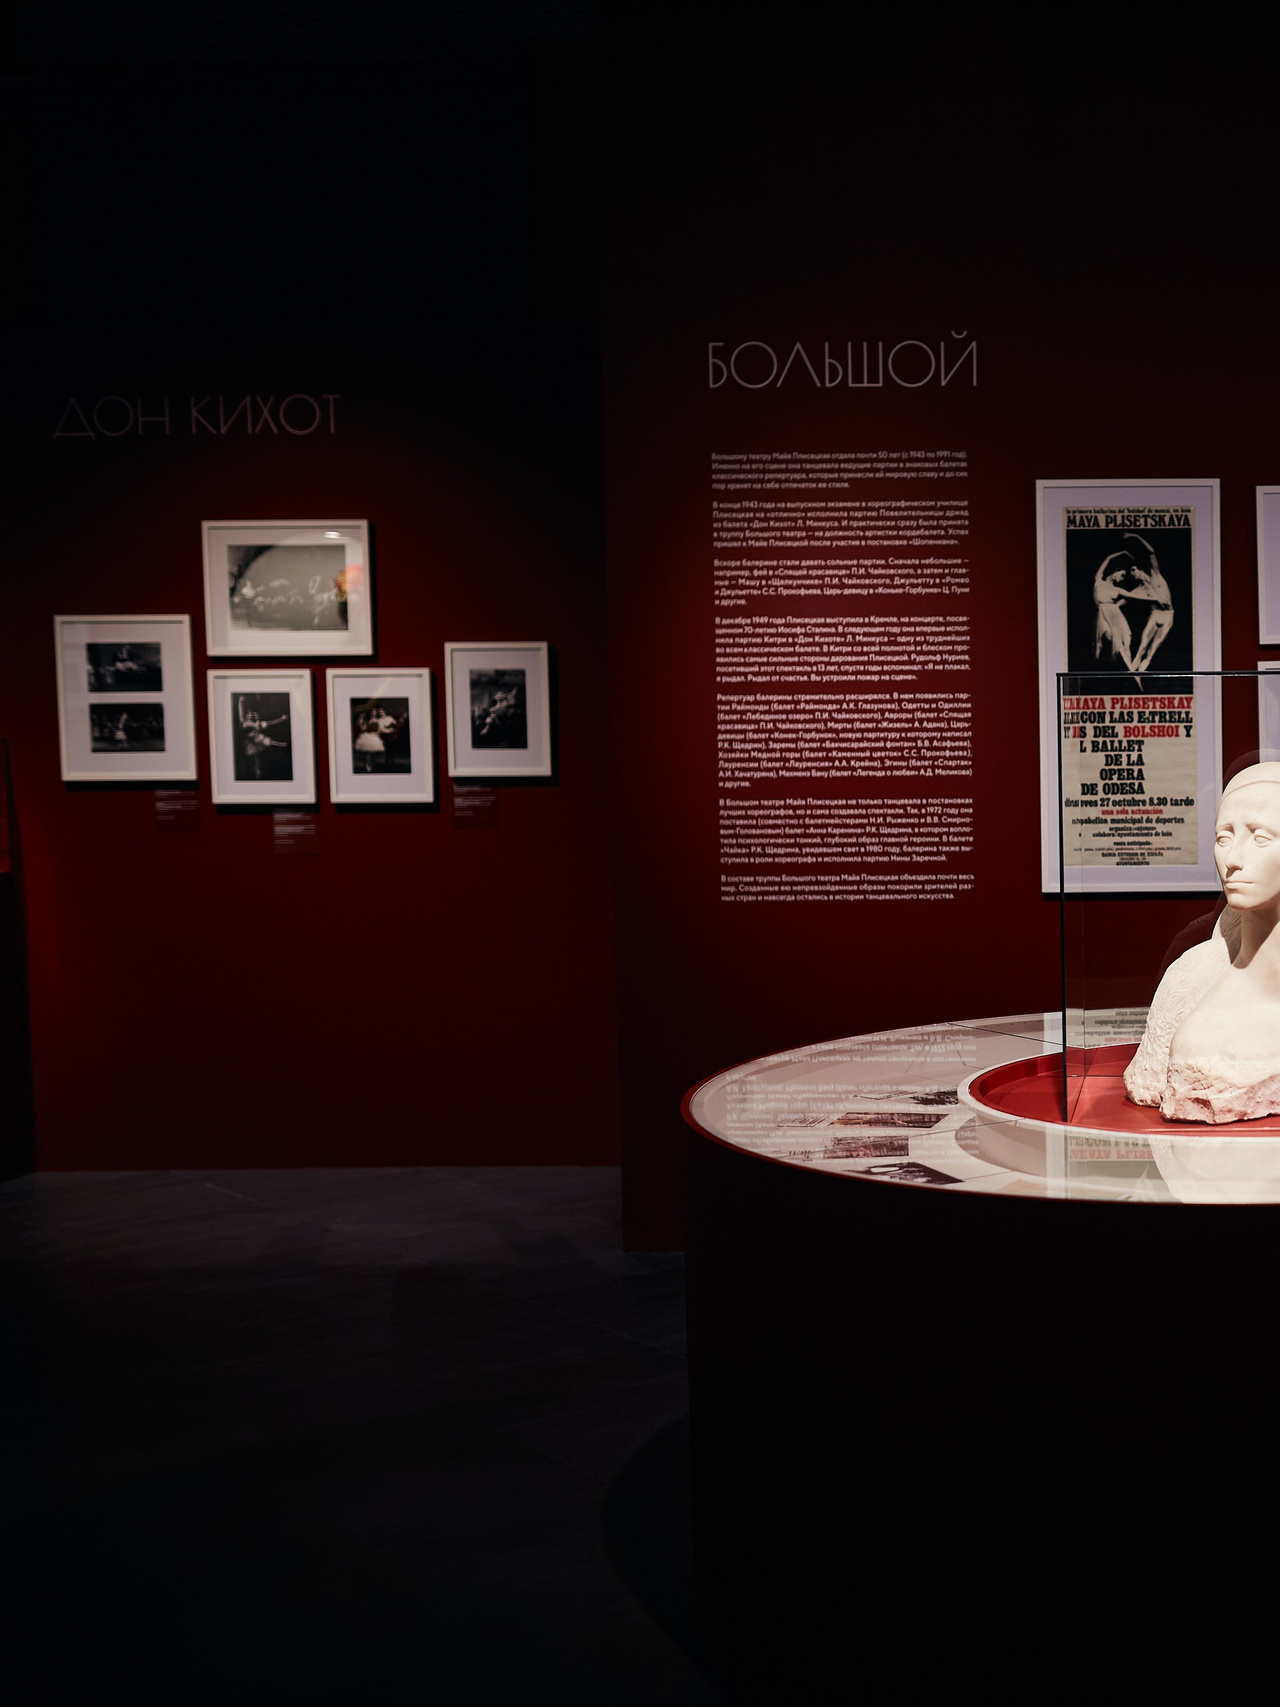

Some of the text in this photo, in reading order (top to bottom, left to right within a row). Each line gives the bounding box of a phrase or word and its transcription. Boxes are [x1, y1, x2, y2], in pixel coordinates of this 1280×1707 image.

[708, 330, 978, 389] БОЛЬШОЙ
[52, 393, 342, 440] ДОН КИХОТ
[1067, 514, 1191, 527] MAYA PLISETSKAYA
[1111, 696, 1193, 709] PLISETSKAY
[1080, 711, 1105, 724] CON
[1109, 711, 1134, 724] LAS
[1093, 726, 1118, 738] DEL
[1123, 725, 1179, 738] BOLSHOI
[1183, 725, 1193, 737] Y
[1091, 740, 1144, 753] BALLET
[1104, 754, 1144, 766] DE LA
[1100, 768, 1145, 781] OPERA
[1081, 783, 1145, 795] DE ODESA
[1100, 798, 1110, 807] 27
[1112, 797, 1147, 807] octubre
[1149, 797, 1167, 806] 8.30
[1170, 797, 1195, 806] tarde
[1110, 816, 1143, 825] municipal
[1155, 816, 1185, 825] deportes
